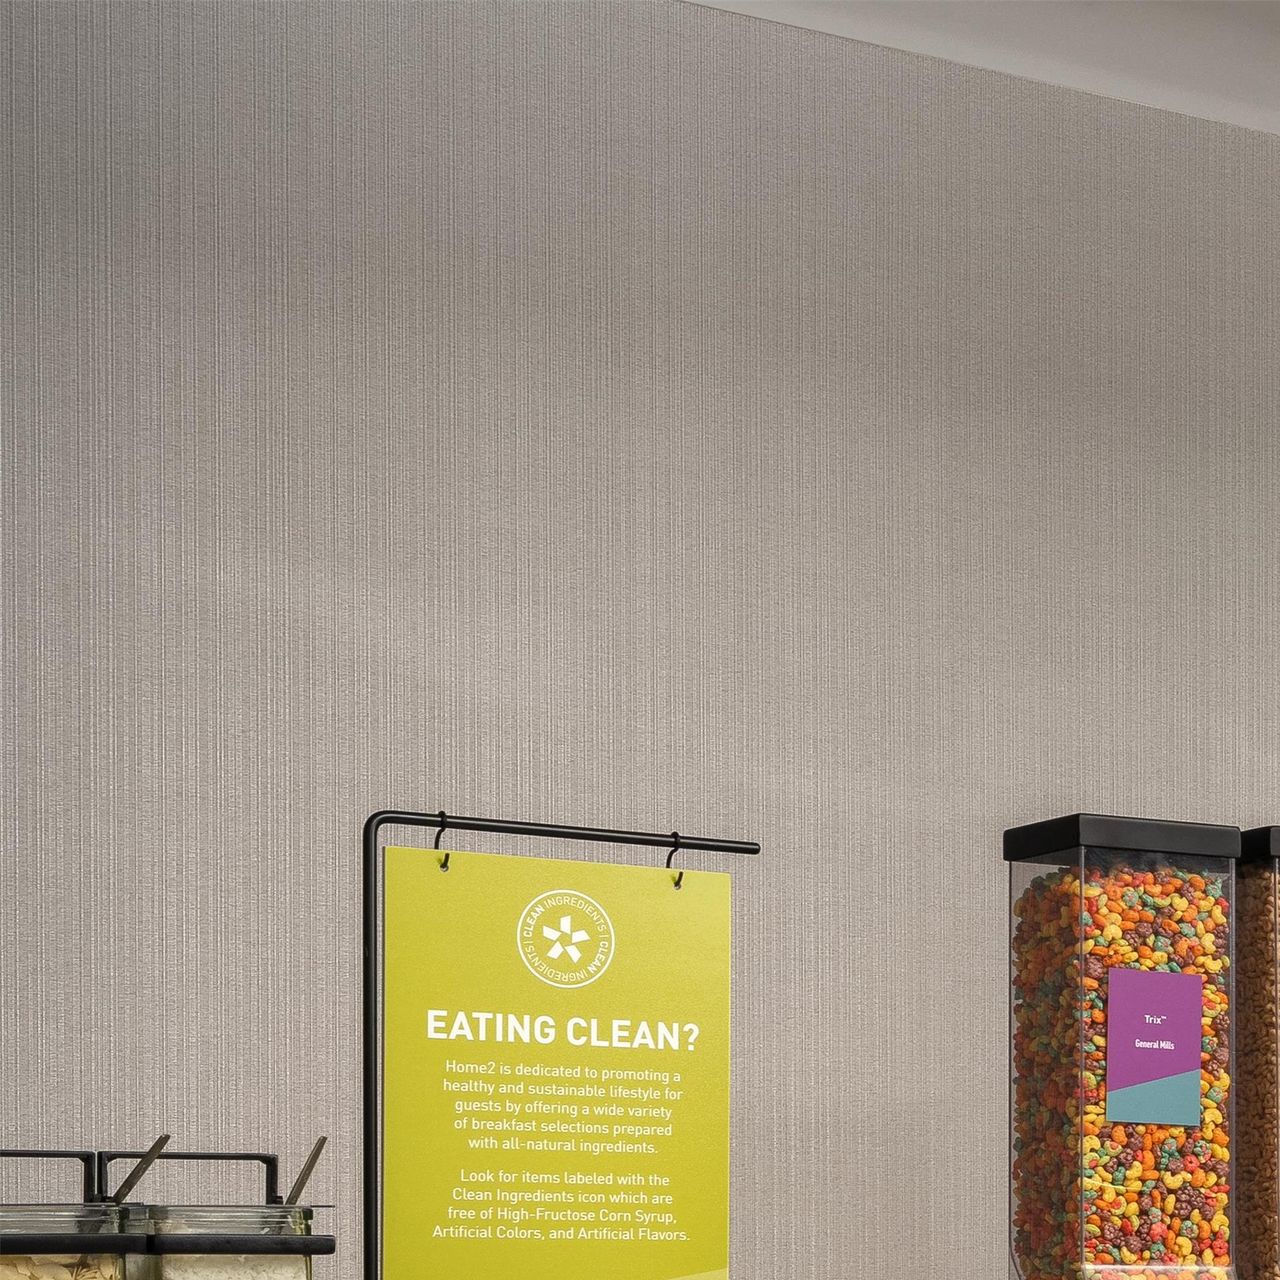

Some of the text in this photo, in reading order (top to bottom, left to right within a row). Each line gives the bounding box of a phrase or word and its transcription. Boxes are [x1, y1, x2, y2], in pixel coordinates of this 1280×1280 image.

[523, 895, 607, 938] CLEAN INGREDIENTS
[525, 941, 609, 982] CLEAN INGREDIENTS
[427, 1010, 700, 1052] EATING CLEAN?
[1135, 1039, 1175, 1050] General Mills
[445, 1060, 682, 1085] Home2 is dedicated to promoting a
[443, 1079, 684, 1103] healthy and sustainable lifestyle for
[455, 1099, 673, 1121] guests by offering a wide variety
[454, 1117, 673, 1139] of breakfast selections prepared
[468, 1136, 659, 1156] with all-natural ingredients.
[460, 1169, 670, 1186] Look for items labeled with the
[453, 1188, 673, 1206] Clean Ingredients icon which are
[448, 1207, 678, 1227] free of High-Fructose Corn Syrup,
[432, 1225, 691, 1242] Artificial Colors, and Artificial Flavors.
